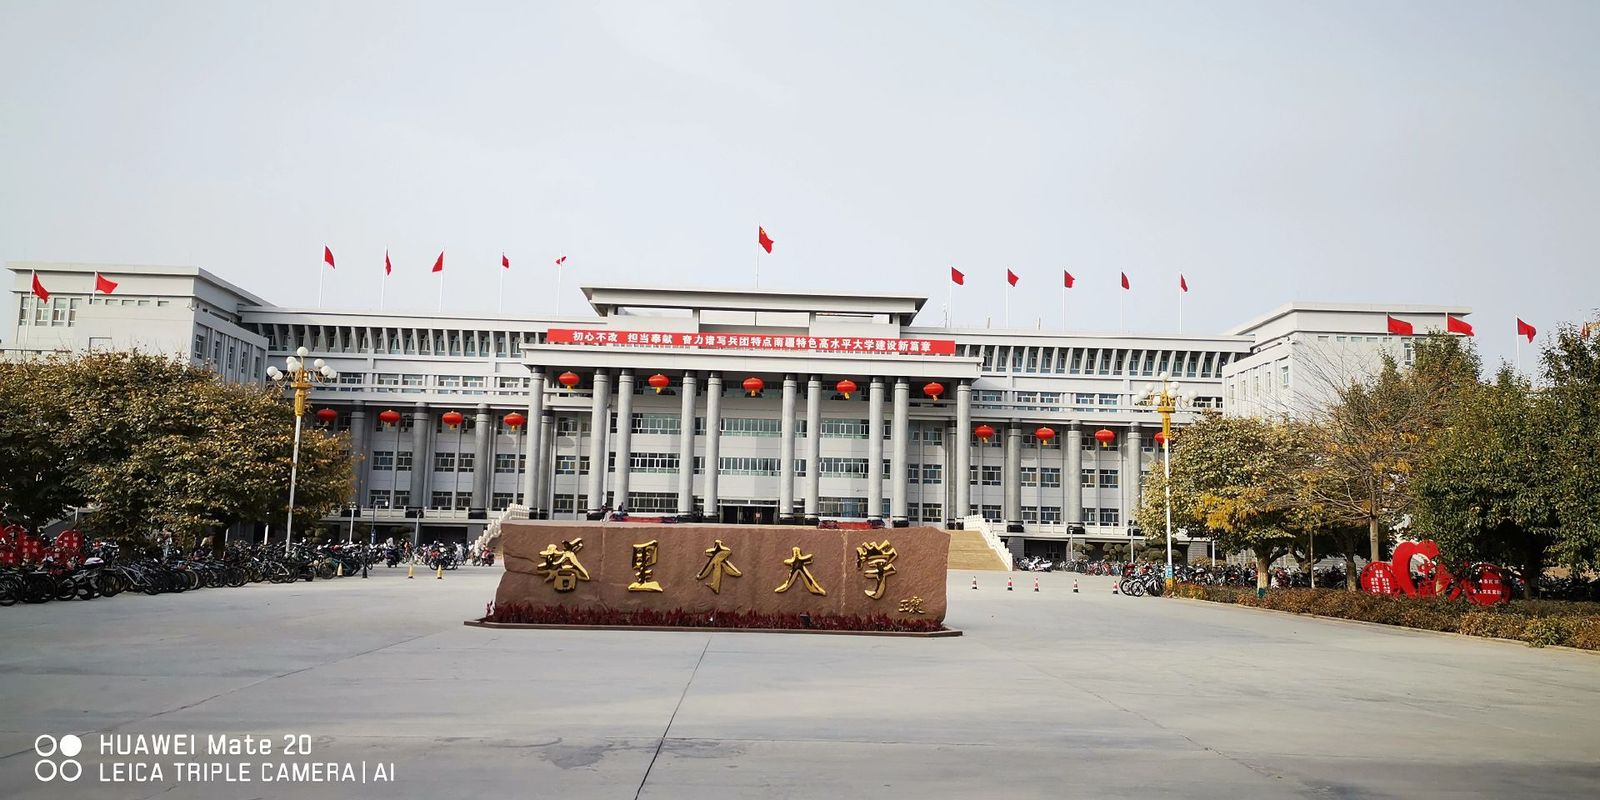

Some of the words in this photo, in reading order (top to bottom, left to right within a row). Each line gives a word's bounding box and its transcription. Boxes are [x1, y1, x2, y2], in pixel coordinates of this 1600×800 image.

[573, 331, 618, 342] 初心不改
[627, 332, 673, 344] 担当奉献
[537, 537, 898, 599] 塔里木大学
